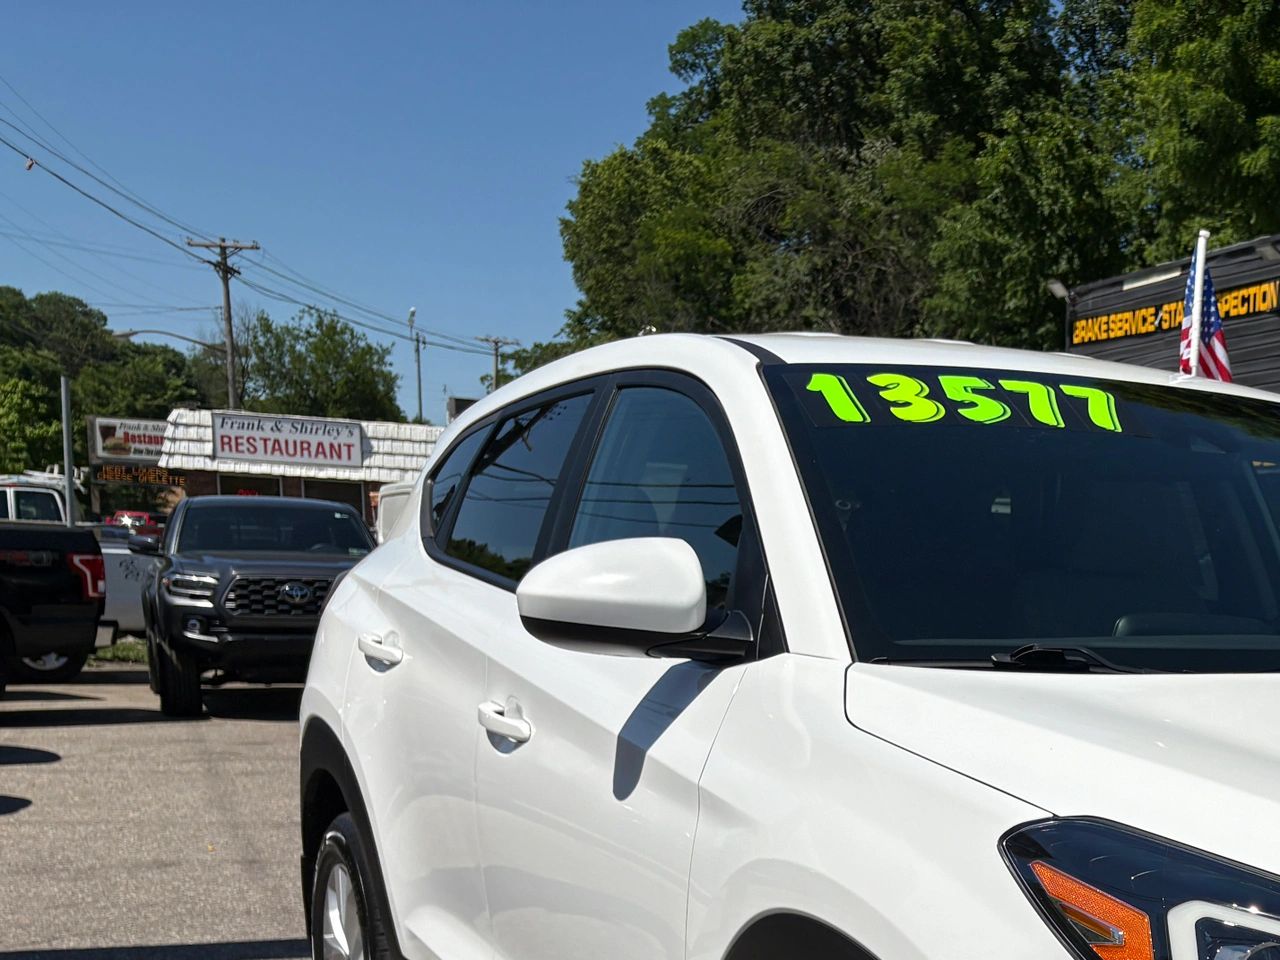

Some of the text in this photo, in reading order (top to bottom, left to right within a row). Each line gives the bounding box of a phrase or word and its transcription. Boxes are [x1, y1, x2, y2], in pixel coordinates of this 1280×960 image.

[1073, 315, 1109, 344] BRAKE
[1109, 306, 1156, 339] SERVICE
[1162, 301, 1185, 330] STA
[1217, 281, 1280, 319] PECTION
[806, 373, 1123, 433] 13577
[220, 417, 355, 441] Frank & Shirley's
[220, 434, 355, 461] RESTAURANT
